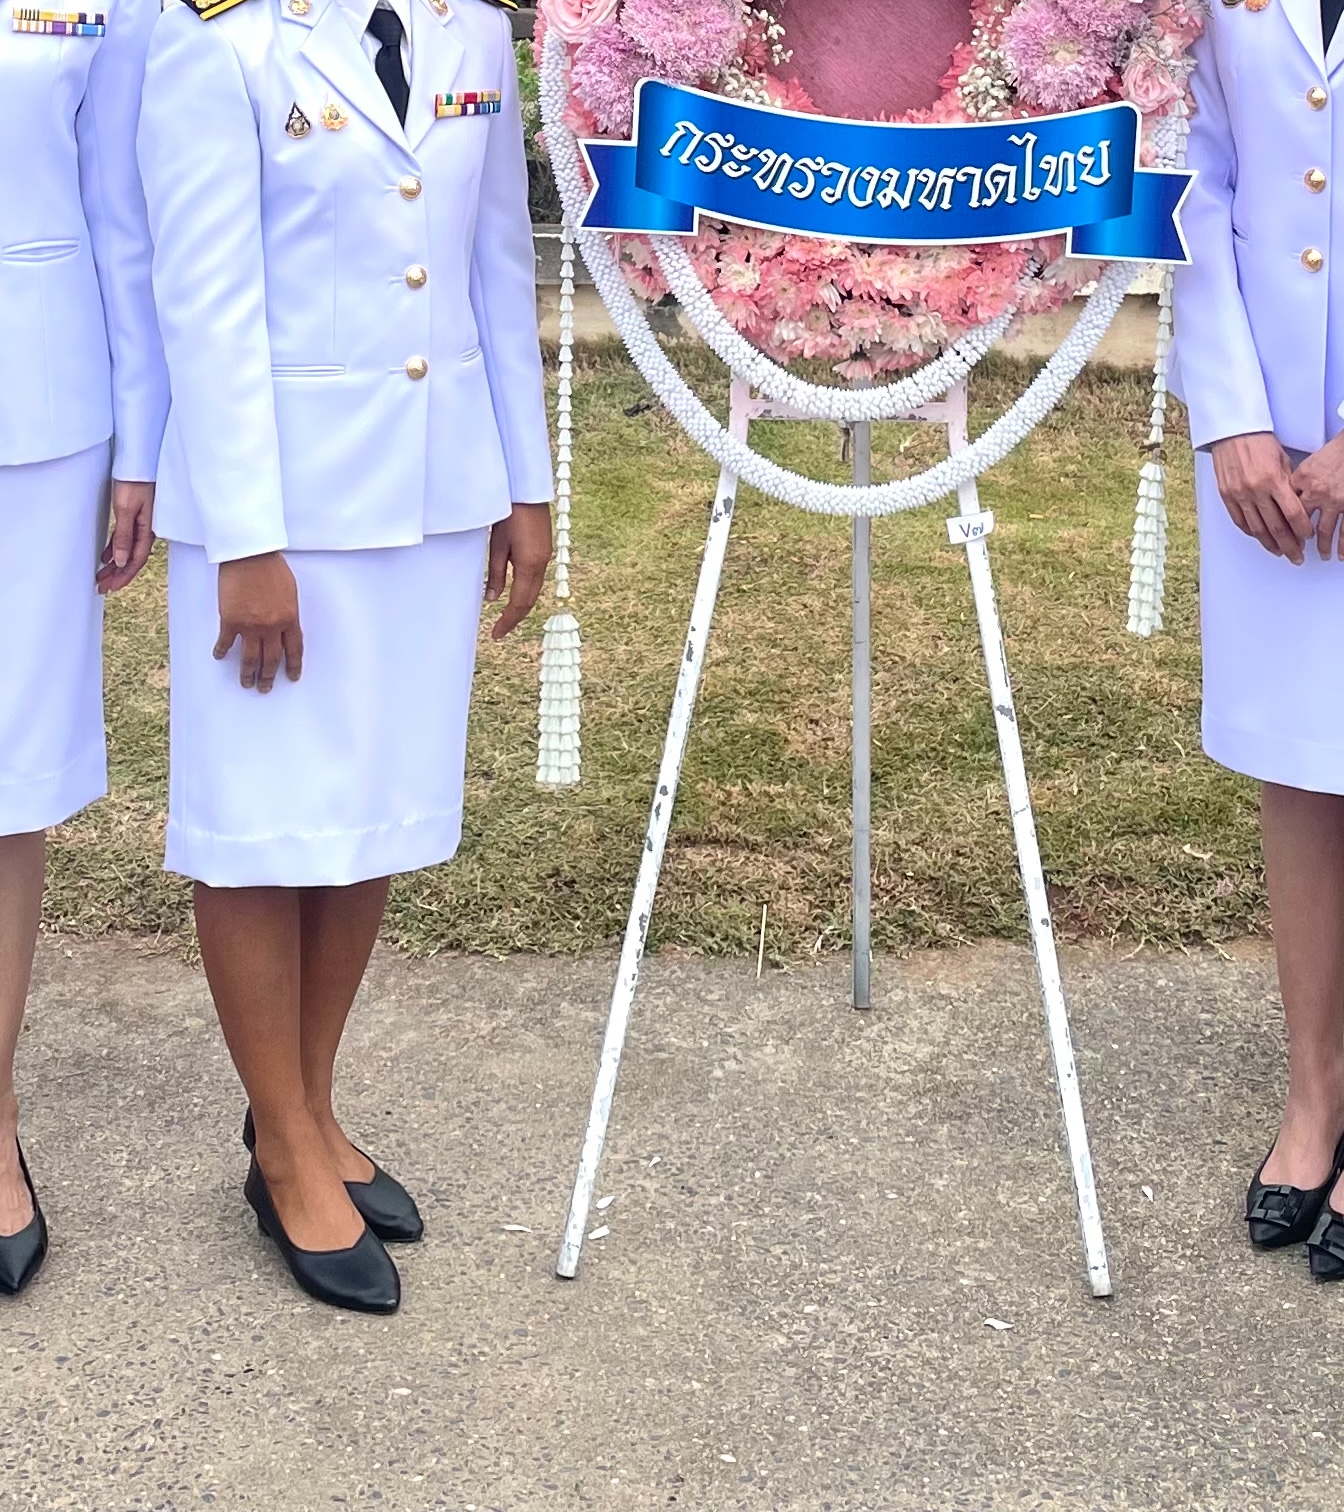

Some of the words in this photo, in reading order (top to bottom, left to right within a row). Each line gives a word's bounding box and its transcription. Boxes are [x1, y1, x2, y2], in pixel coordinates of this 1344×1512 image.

[658, 120, 1112, 212] กระทรวงมหาดไทย
